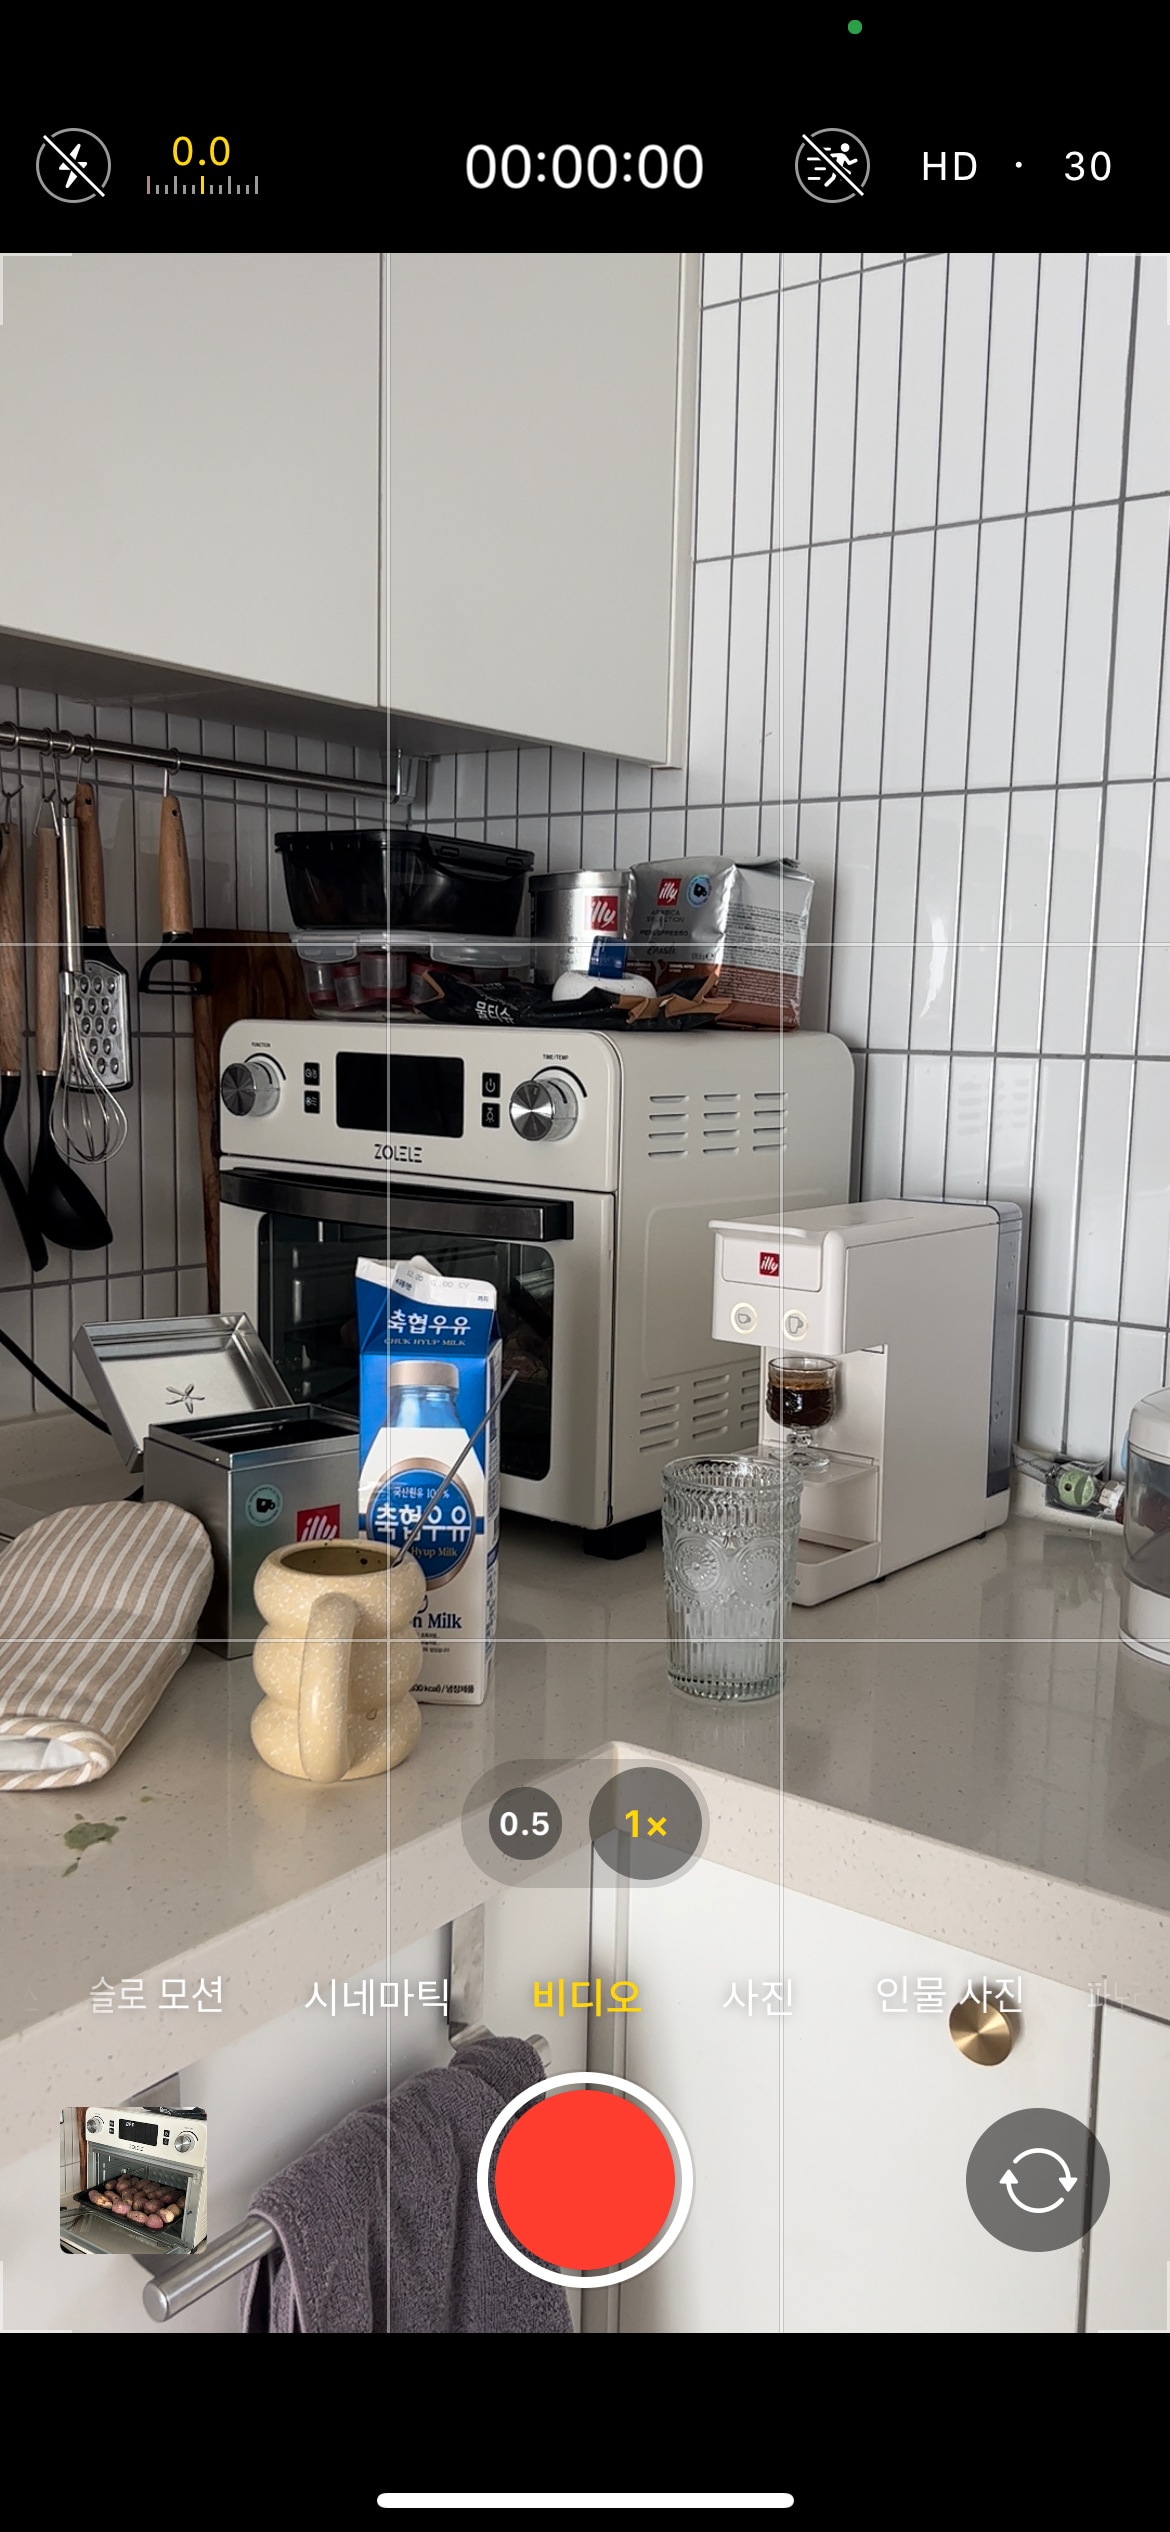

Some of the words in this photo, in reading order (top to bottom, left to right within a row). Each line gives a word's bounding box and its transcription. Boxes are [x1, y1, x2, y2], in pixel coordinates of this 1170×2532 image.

[659, 881, 678, 904] illy
[374, 1143, 423, 1163] ZOLELE
[760, 1255, 779, 1274] illy
[387, 1308, 472, 1336] 축협우유
[442, 1339, 467, 1347] MILK
[374, 1502, 472, 1543] 축협우유
[438, 1546, 459, 1558] Milk
[427, 1611, 463, 1629] Milk
